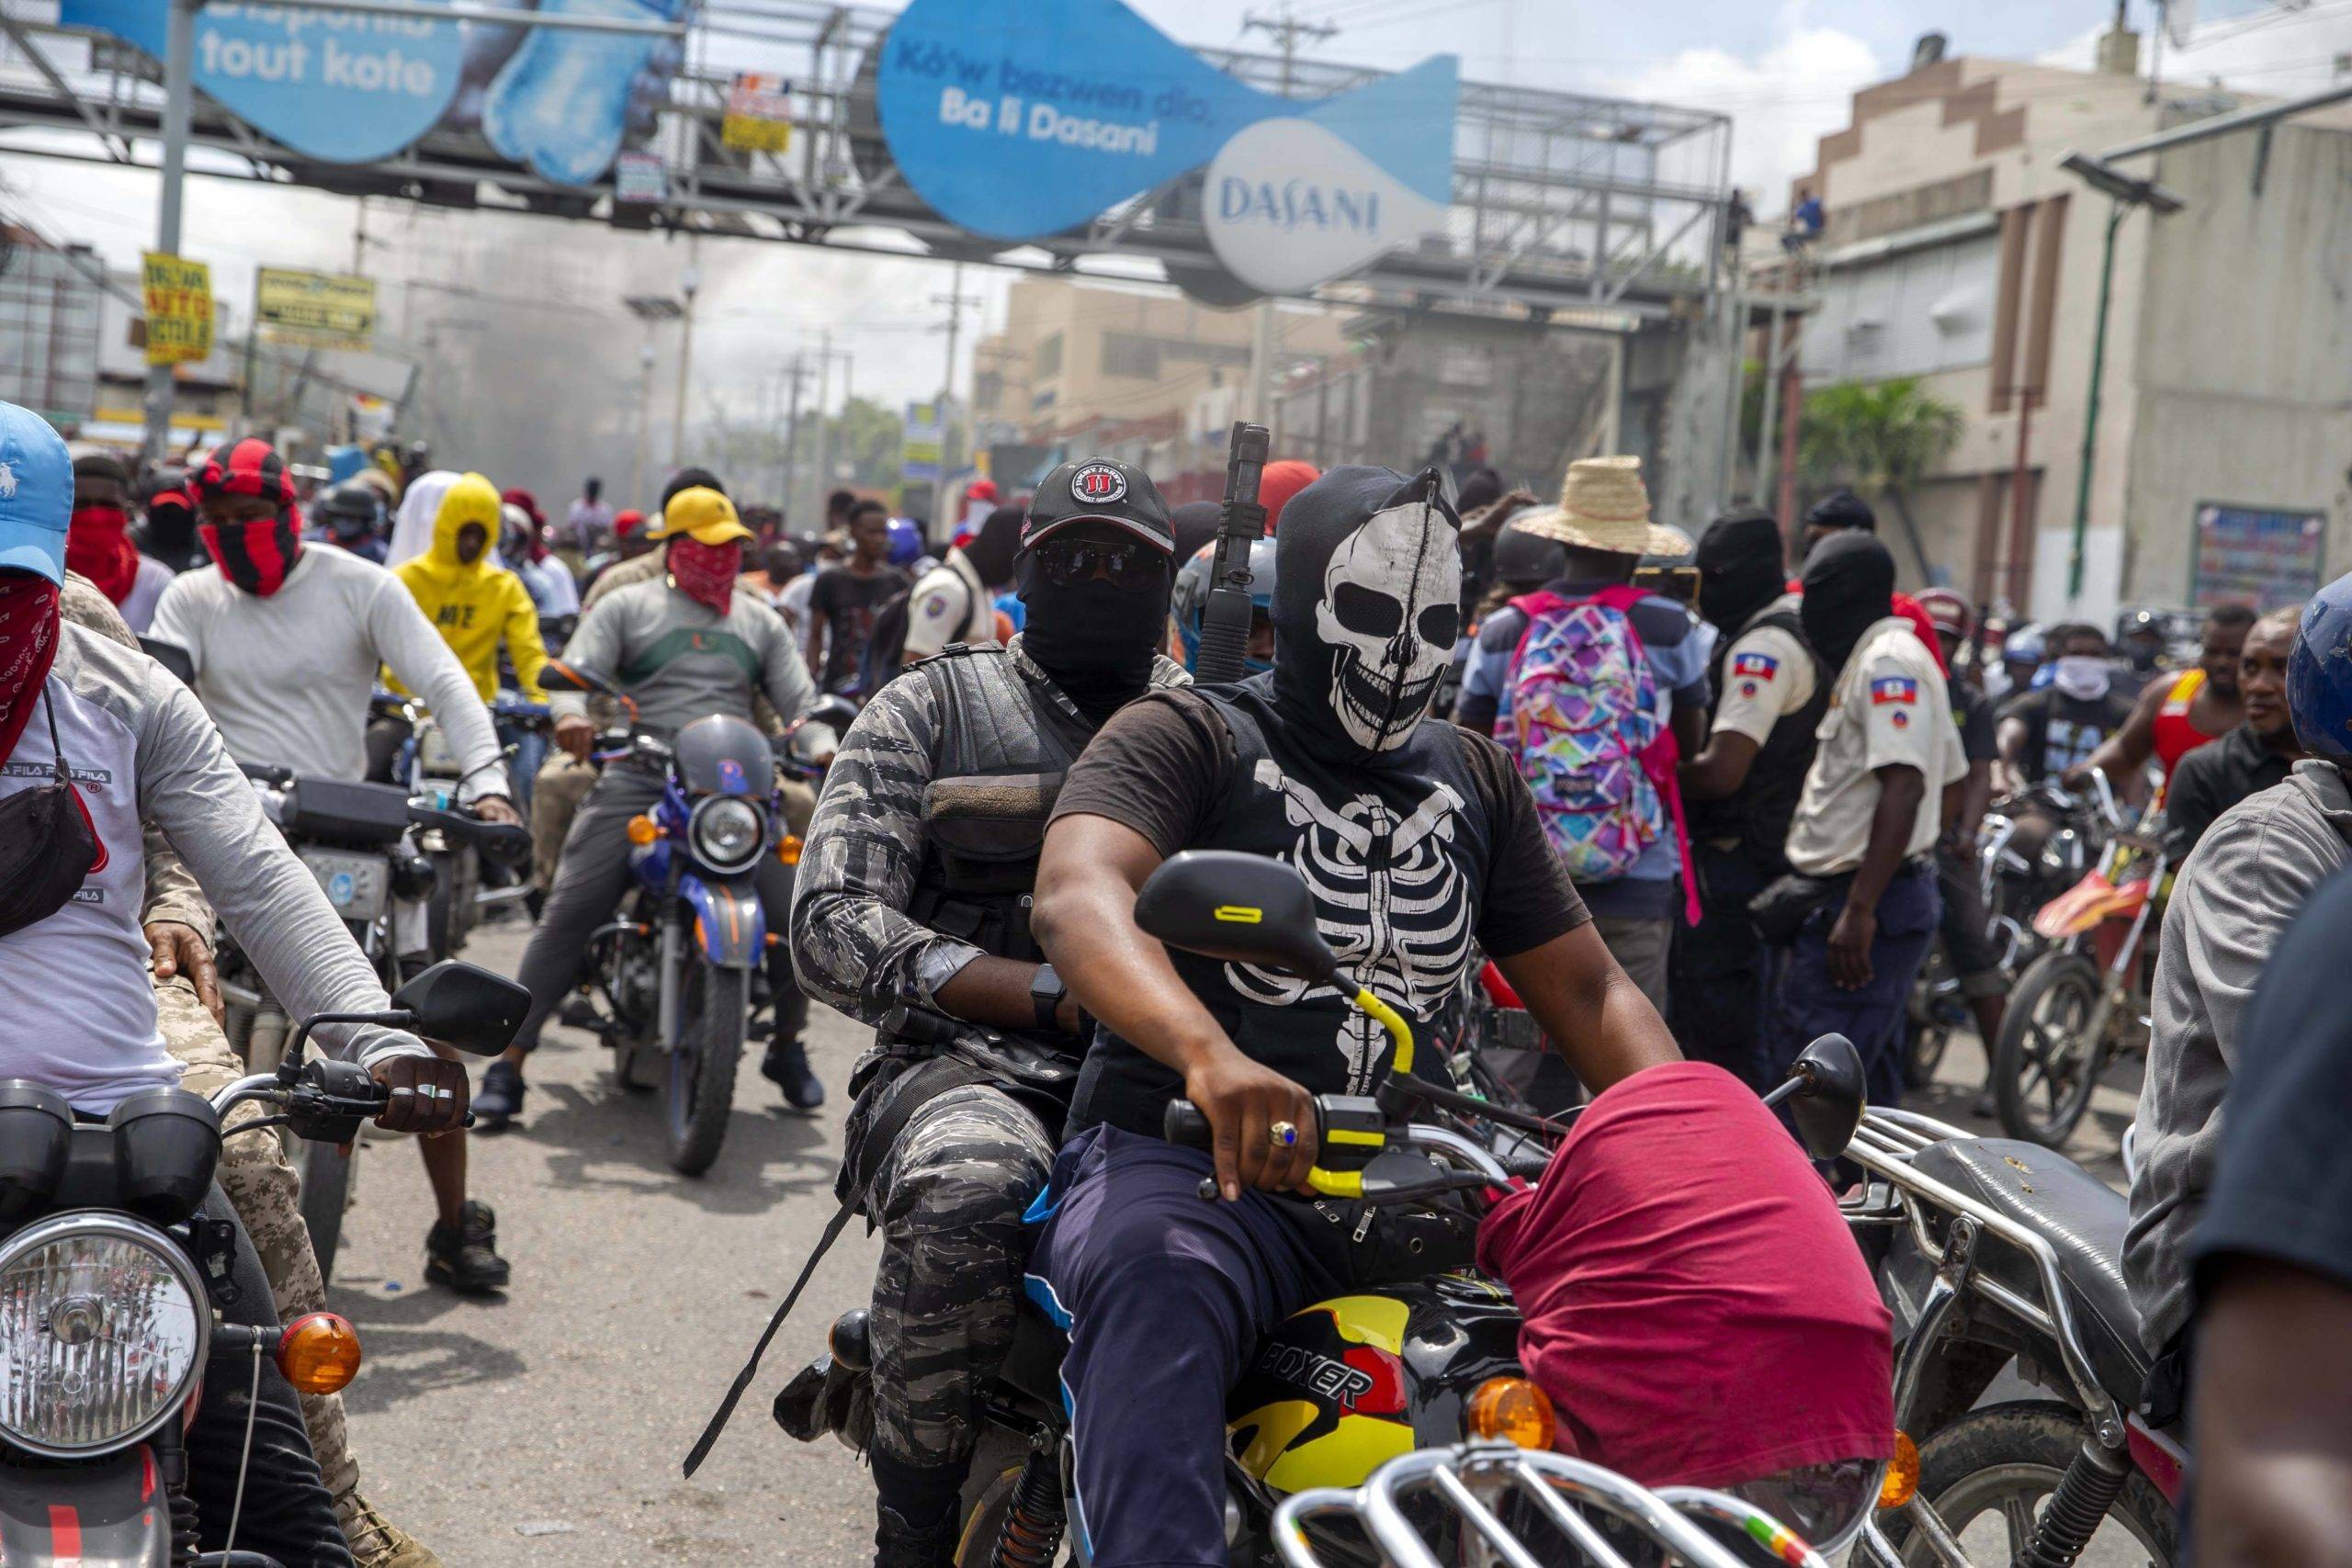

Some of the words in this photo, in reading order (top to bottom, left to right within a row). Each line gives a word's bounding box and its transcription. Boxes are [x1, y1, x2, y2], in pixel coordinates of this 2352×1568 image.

[200, 28, 307, 81] tout
[323, 37, 436, 96] kote
[998, 60, 1143, 111] bezwen
[939, 86, 991, 130] Ba
[1027, 102, 1159, 156] Dasani
[1220, 176, 1380, 235] DASANI
[13, 765, 43, 776] FILA
[76, 770, 107, 782] FILA
[73, 891, 99, 901] FILA
[1256, 1341, 1374, 1409] BOXER
